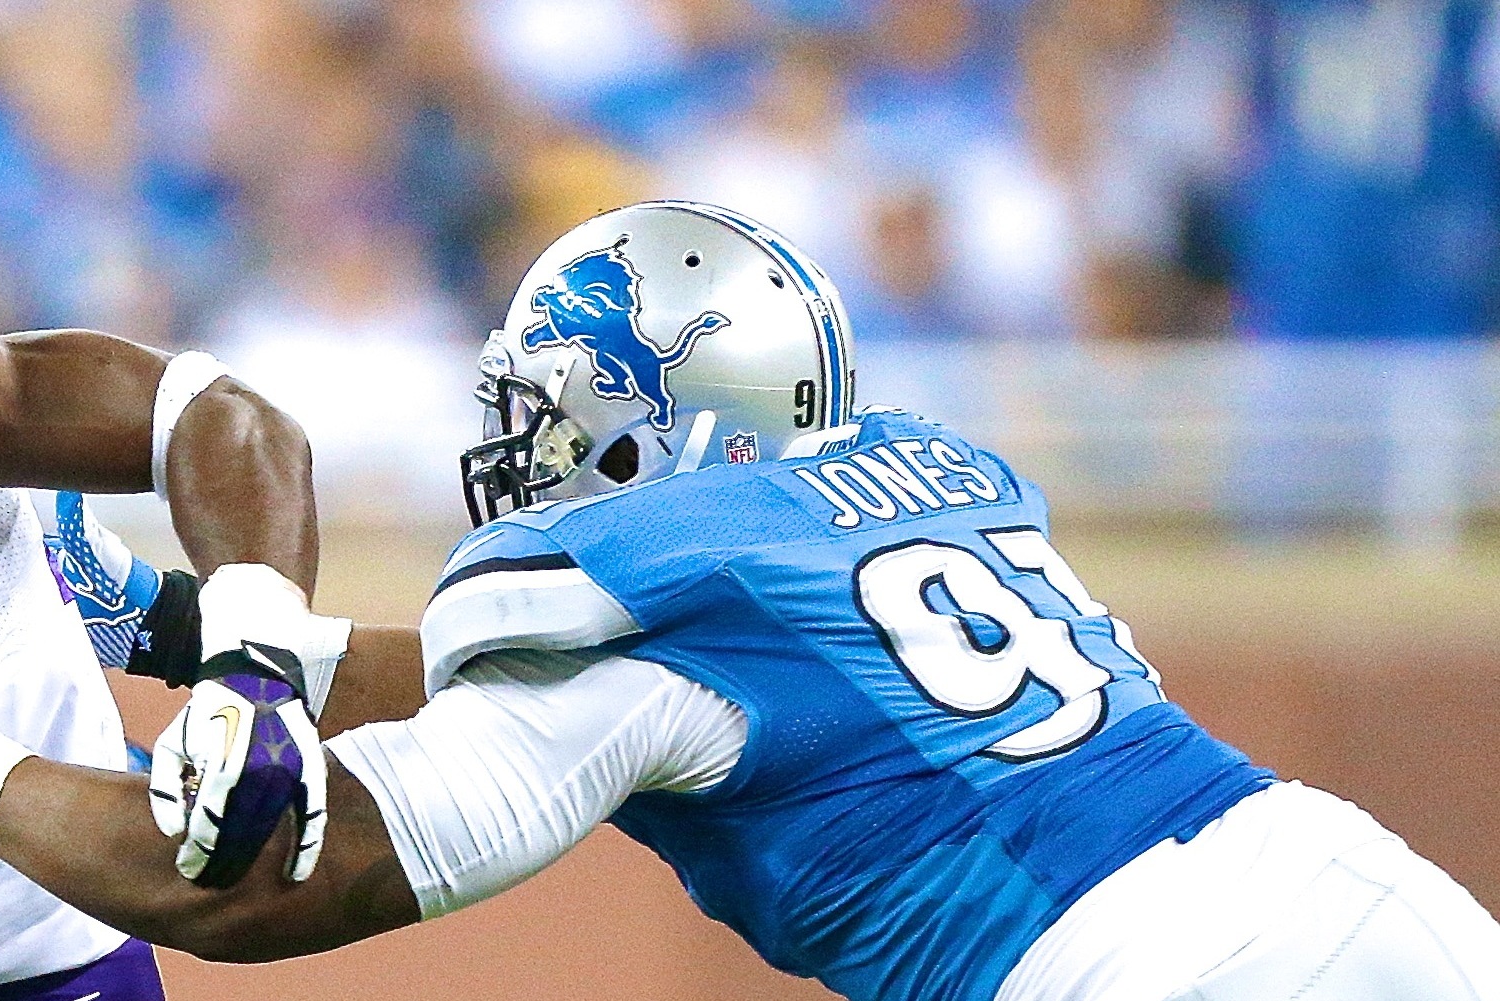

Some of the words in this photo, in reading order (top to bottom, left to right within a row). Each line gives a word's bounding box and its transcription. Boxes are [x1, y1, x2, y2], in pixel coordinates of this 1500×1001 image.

[793, 379, 816, 429] 9
[728, 447, 754, 464] NFL
[794, 438, 1000, 529] JONES
[852, 524, 1169, 764] 97
